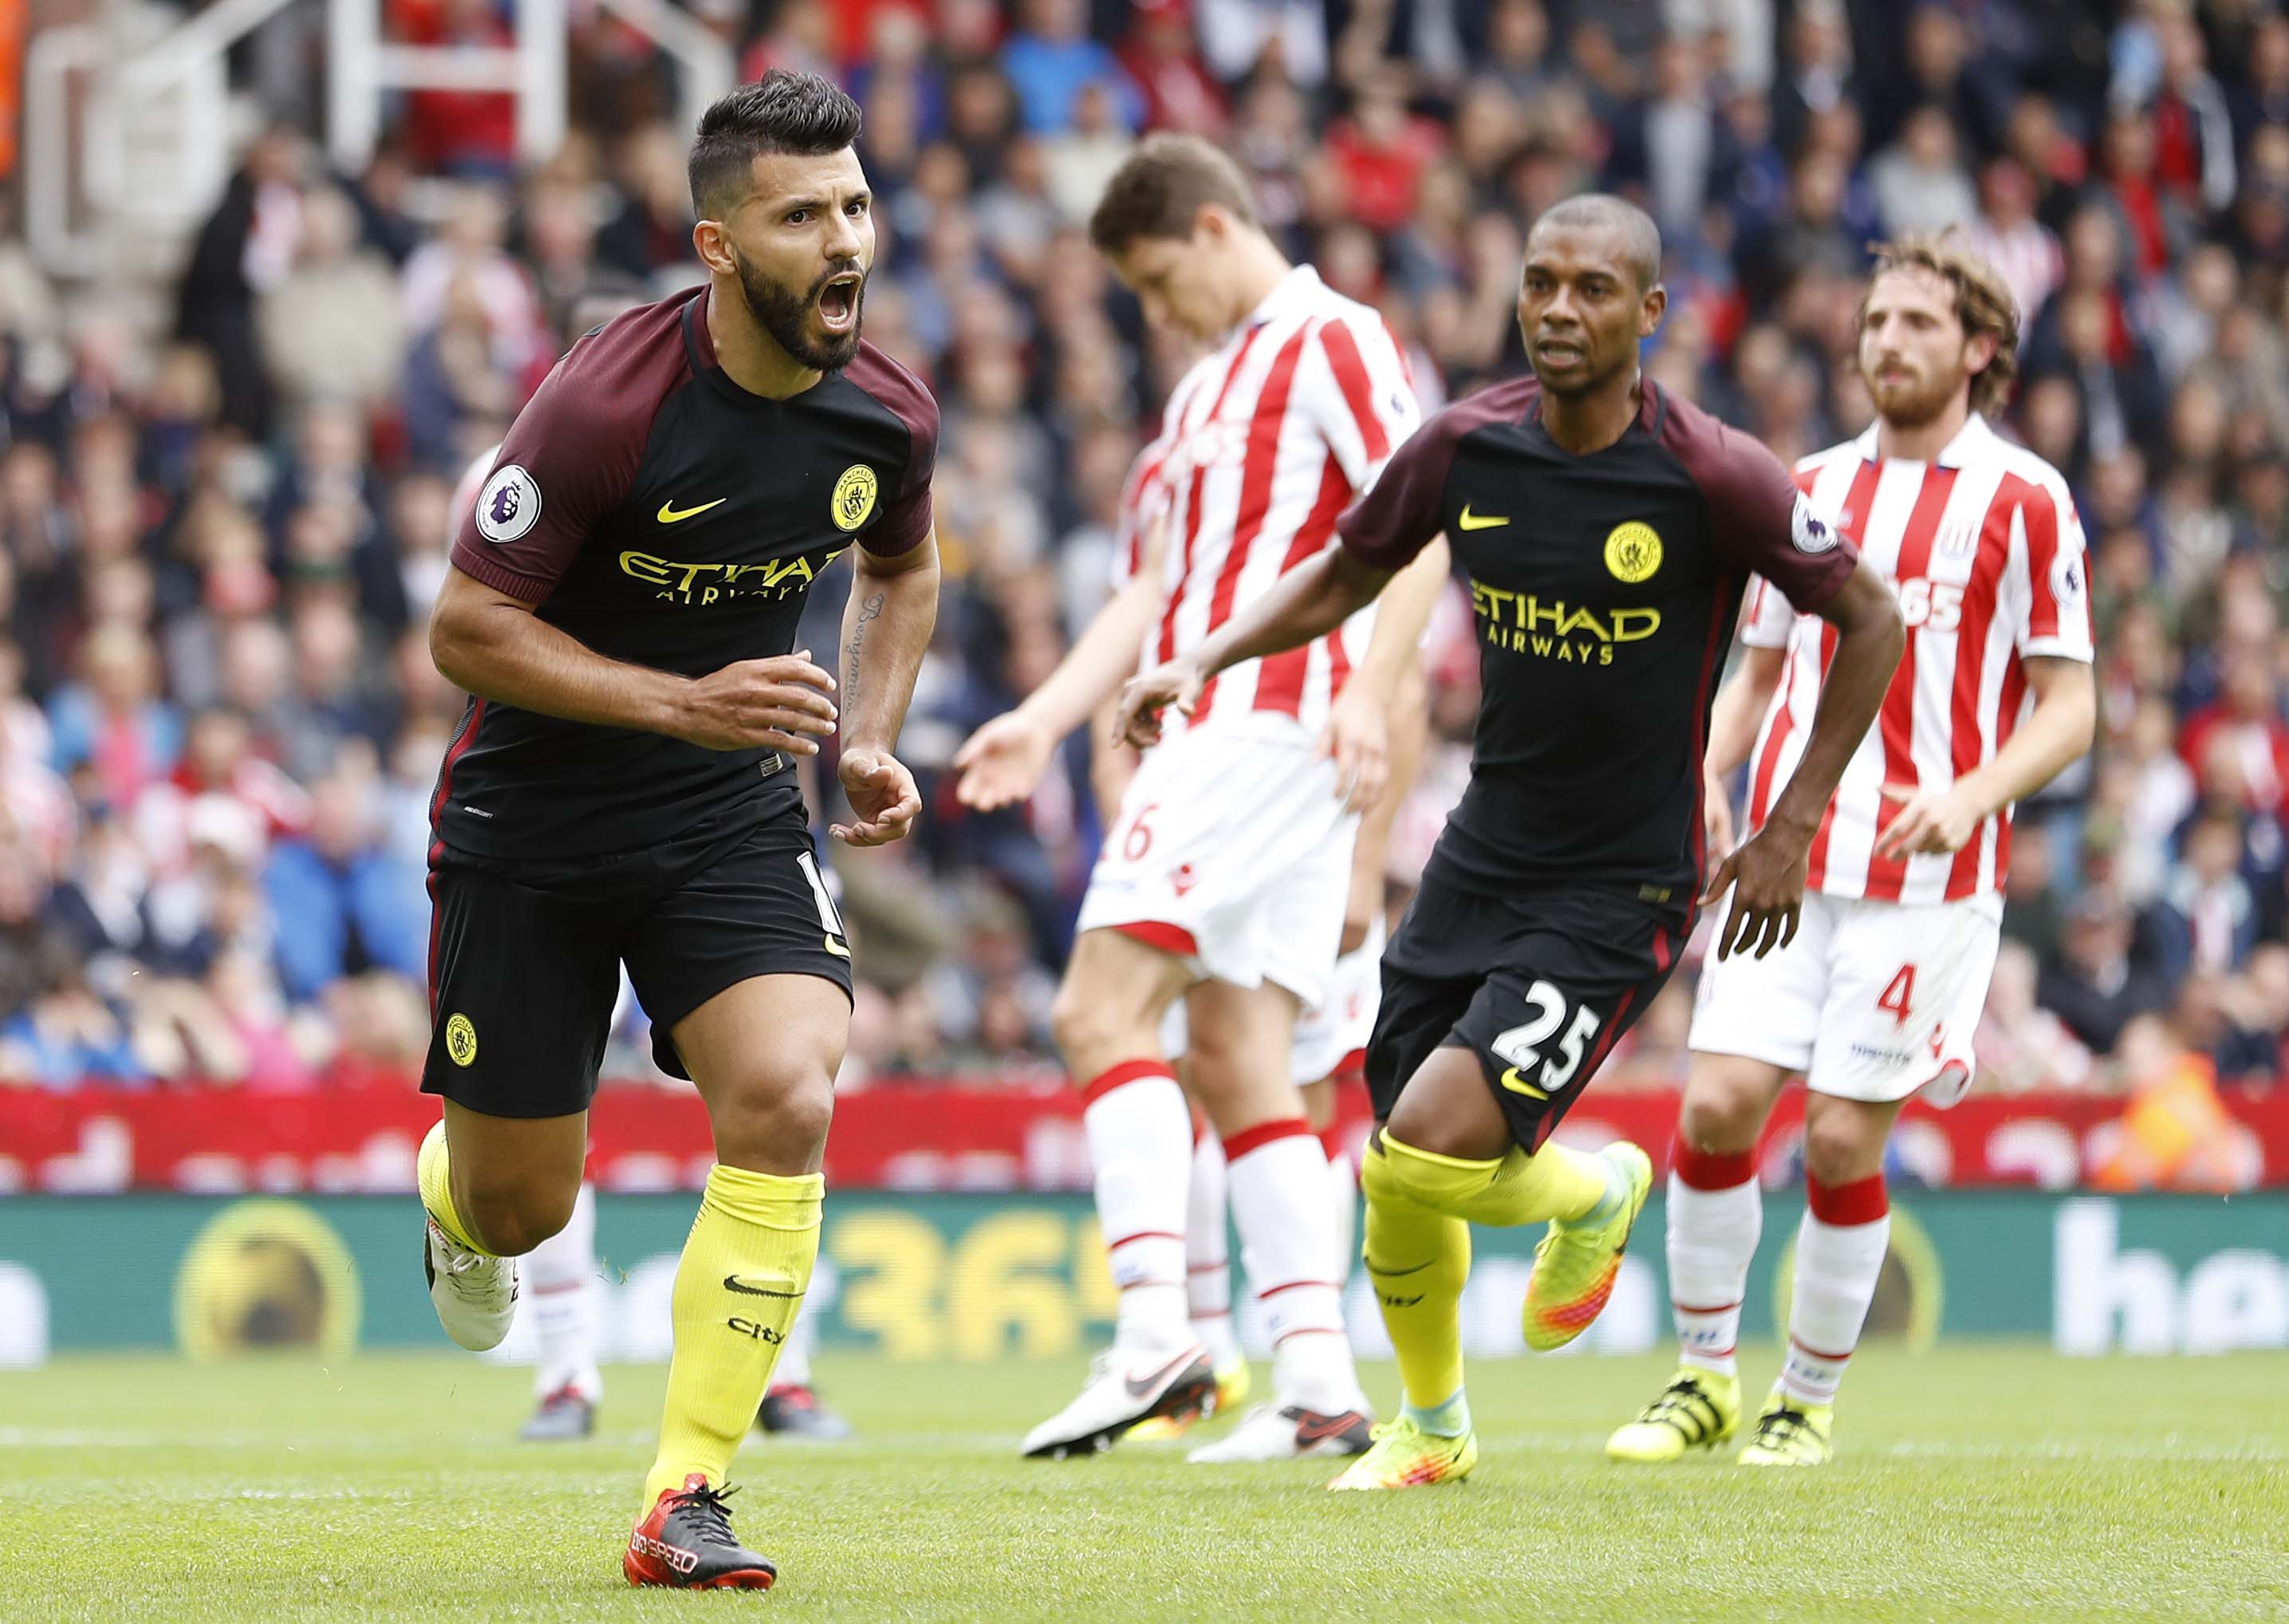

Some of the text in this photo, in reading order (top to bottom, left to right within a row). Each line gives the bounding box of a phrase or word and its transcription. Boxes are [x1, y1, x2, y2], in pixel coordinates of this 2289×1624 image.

[839, 469, 875, 492] MANCHESTER
[1487, 623, 1613, 666] AIRWAYS
[1877, 962, 1917, 1035] 4
[1491, 979, 1602, 1093] 25
[727, 1317, 786, 1346] City
